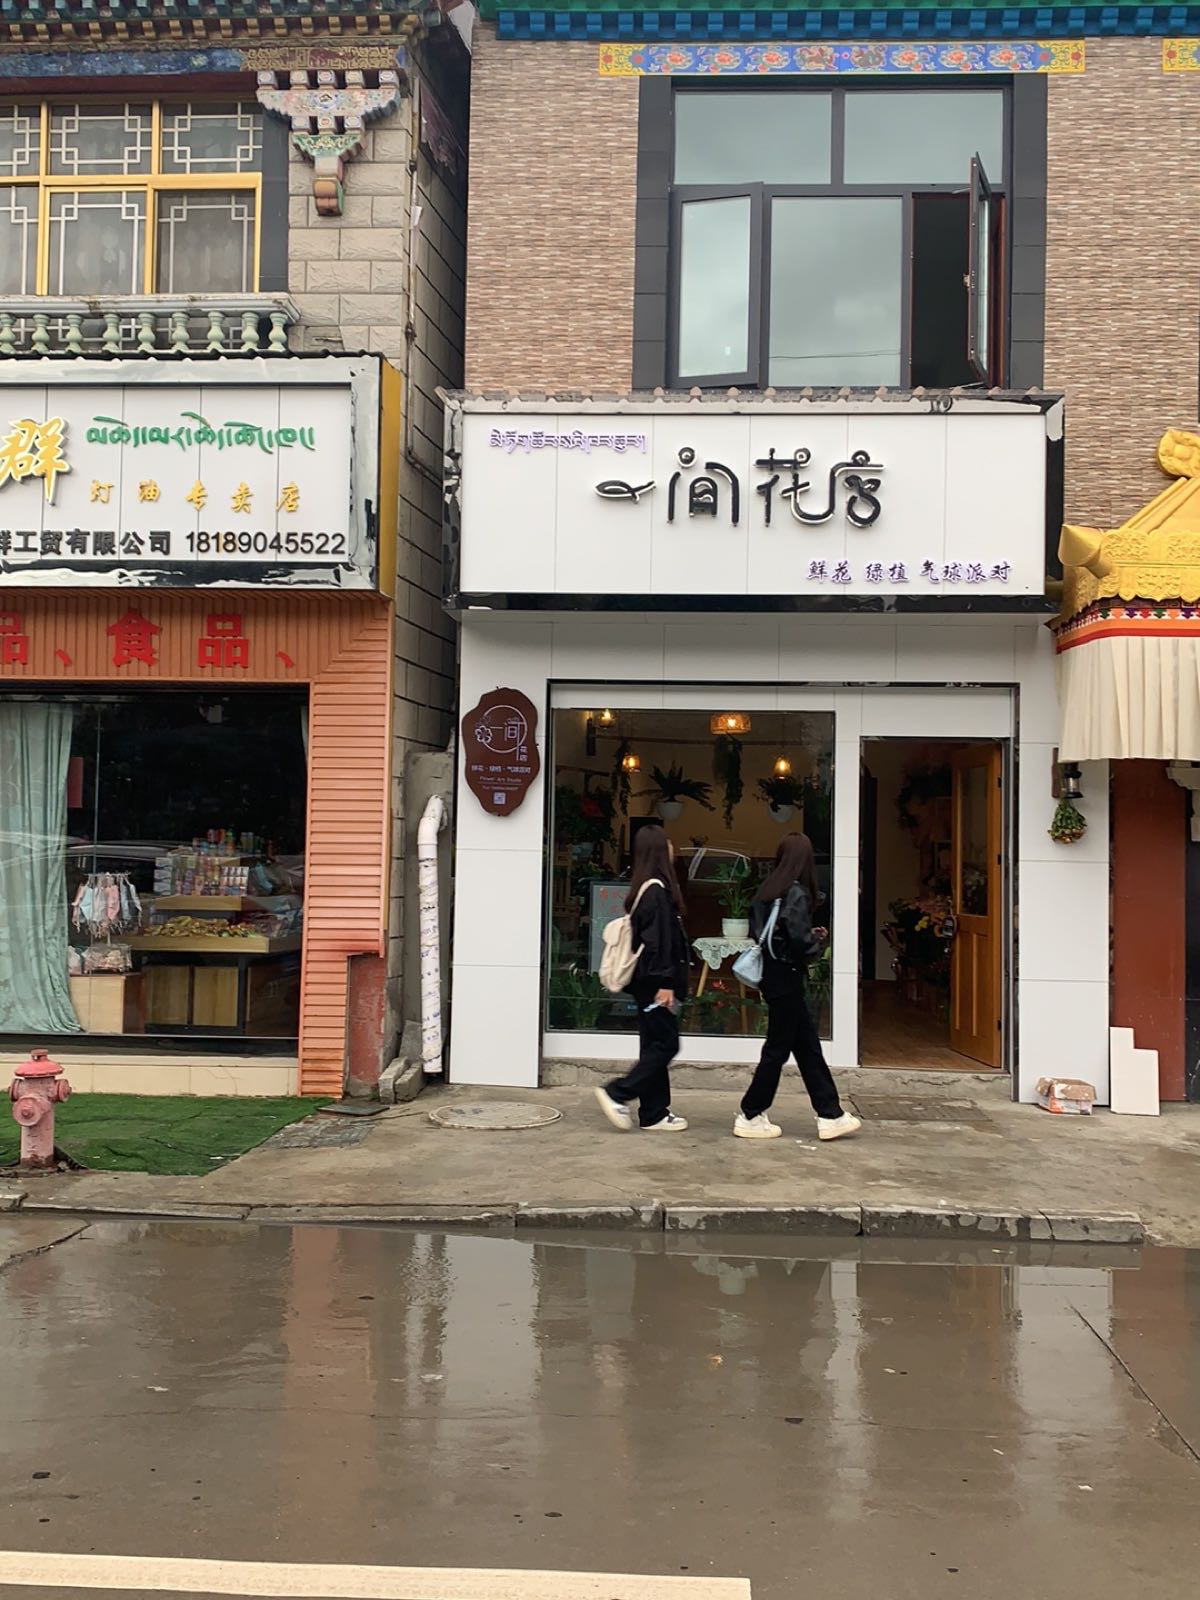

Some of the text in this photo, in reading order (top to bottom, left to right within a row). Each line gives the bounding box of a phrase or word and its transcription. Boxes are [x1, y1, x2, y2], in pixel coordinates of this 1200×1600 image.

[90, 479, 301, 514] 灯油专卖店
[186, 531, 346, 555] 18189045522
[807, 559, 1012, 584] 鲜花 绿植 气球派对
